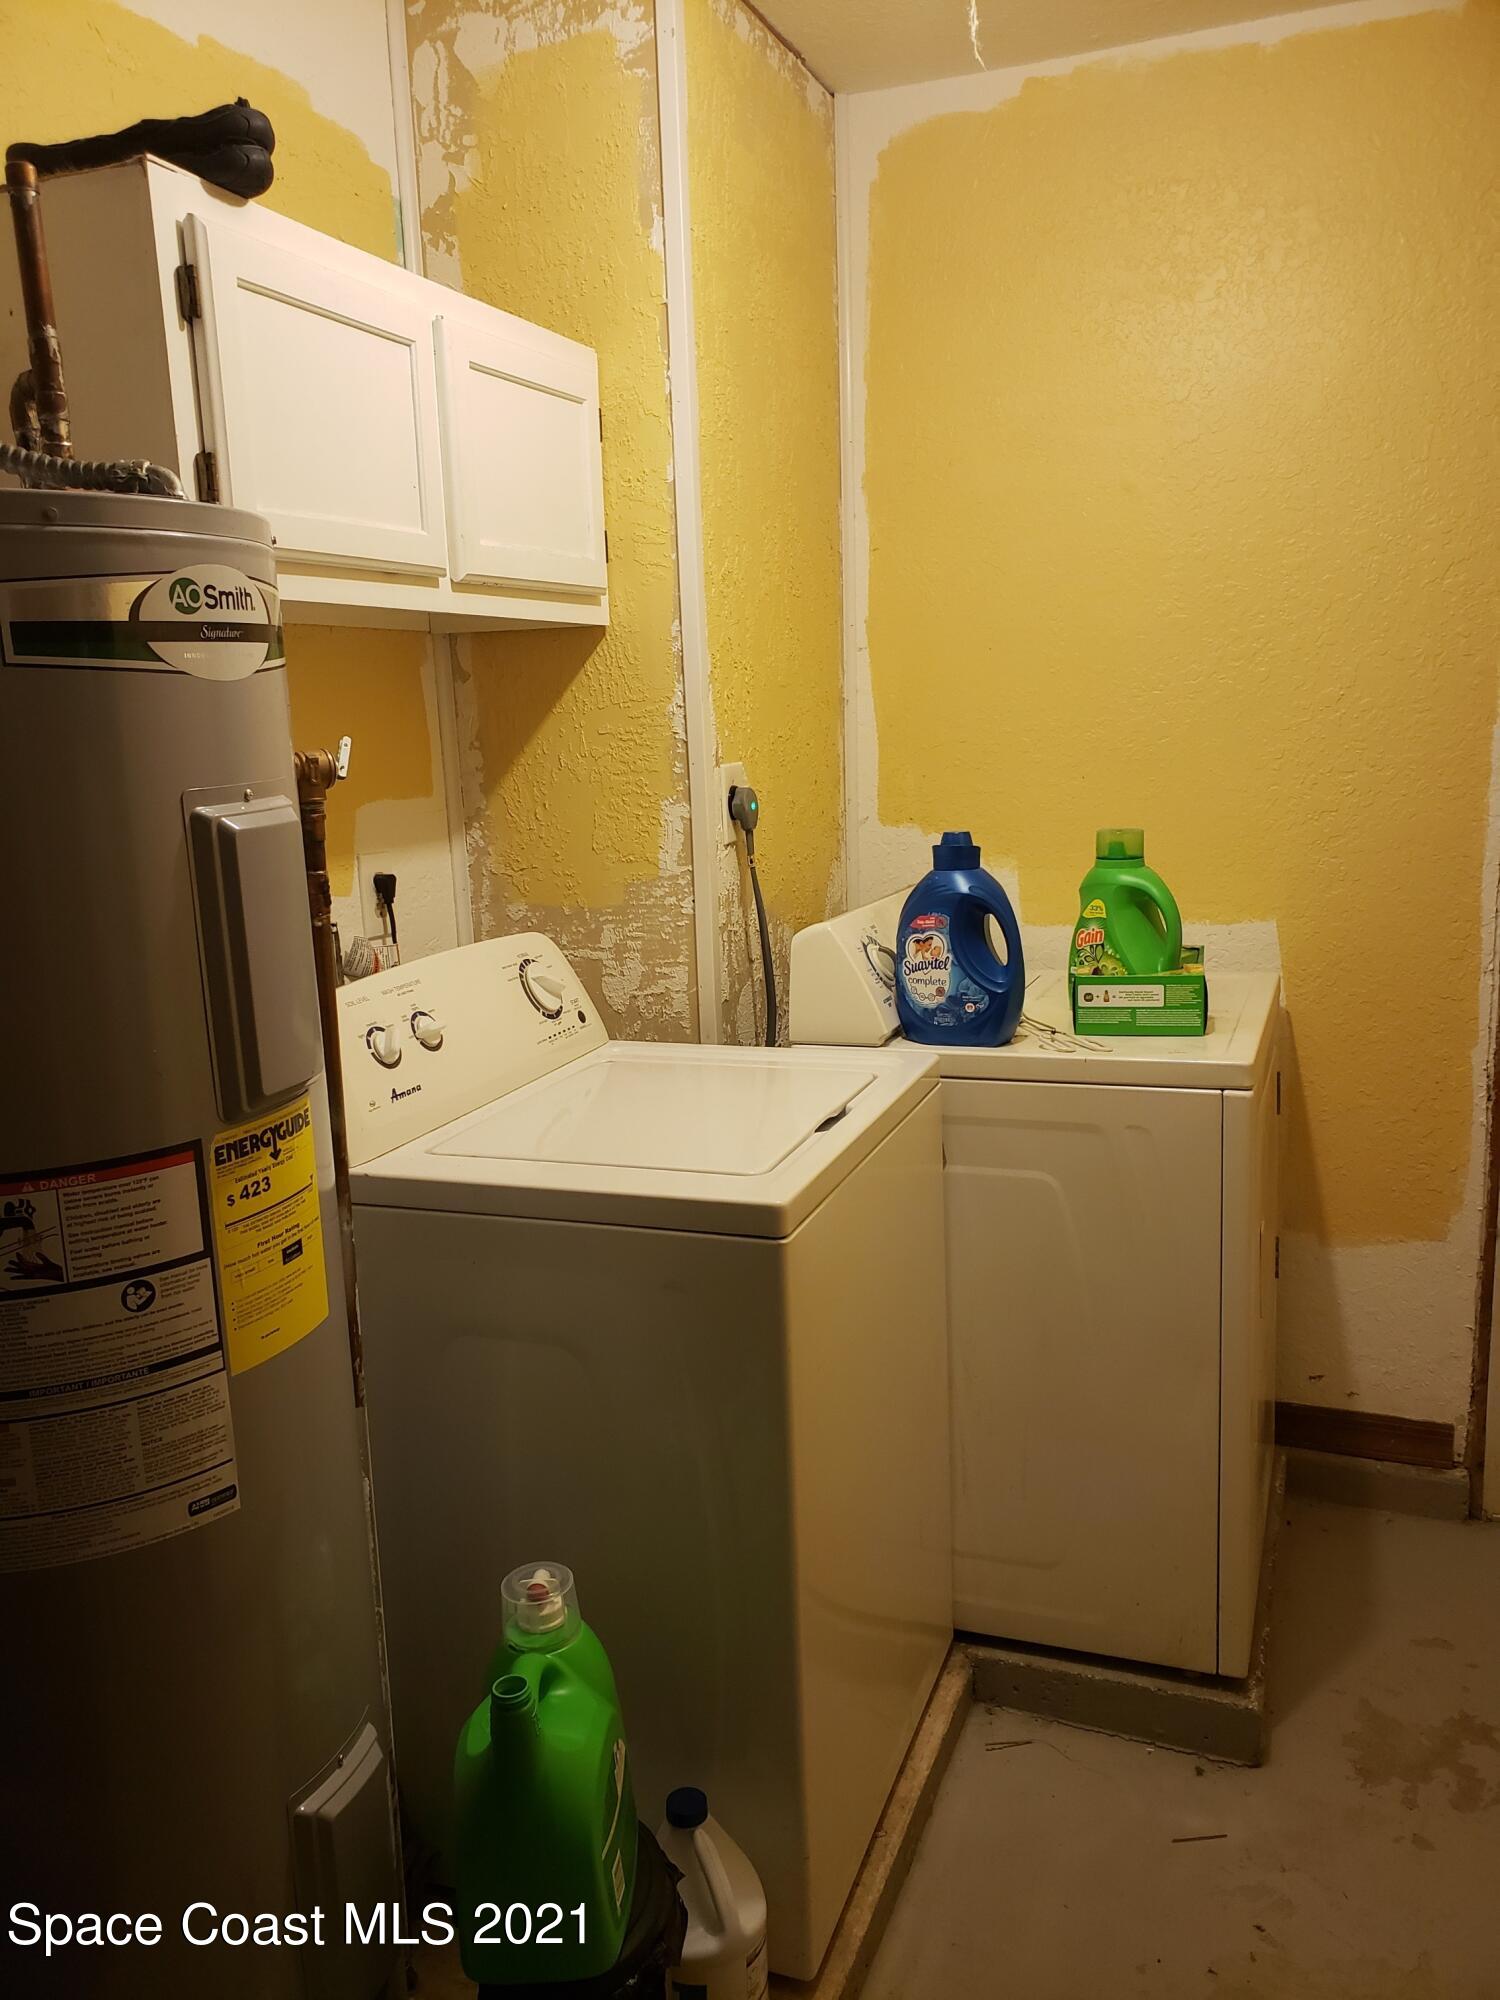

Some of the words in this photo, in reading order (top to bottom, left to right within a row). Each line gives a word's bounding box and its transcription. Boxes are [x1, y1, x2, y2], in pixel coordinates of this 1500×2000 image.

[204, 584, 253, 611] Smith
[200, 624, 243, 640] Signature
[1076, 928, 1104, 947] Gain
[903, 956, 950, 976] Suavitel
[908, 976, 947, 987] complete
[390, 1084, 422, 1103] Amana
[214, 1107, 311, 1166] ENERGYGUIDE
[39, 1173, 97, 1190] DANGER
[240, 1176, 271, 1200] 423
[29, 1381, 85, 1398] IMPORTANT
[91, 1367, 149, 1388] IMPORTANTE
